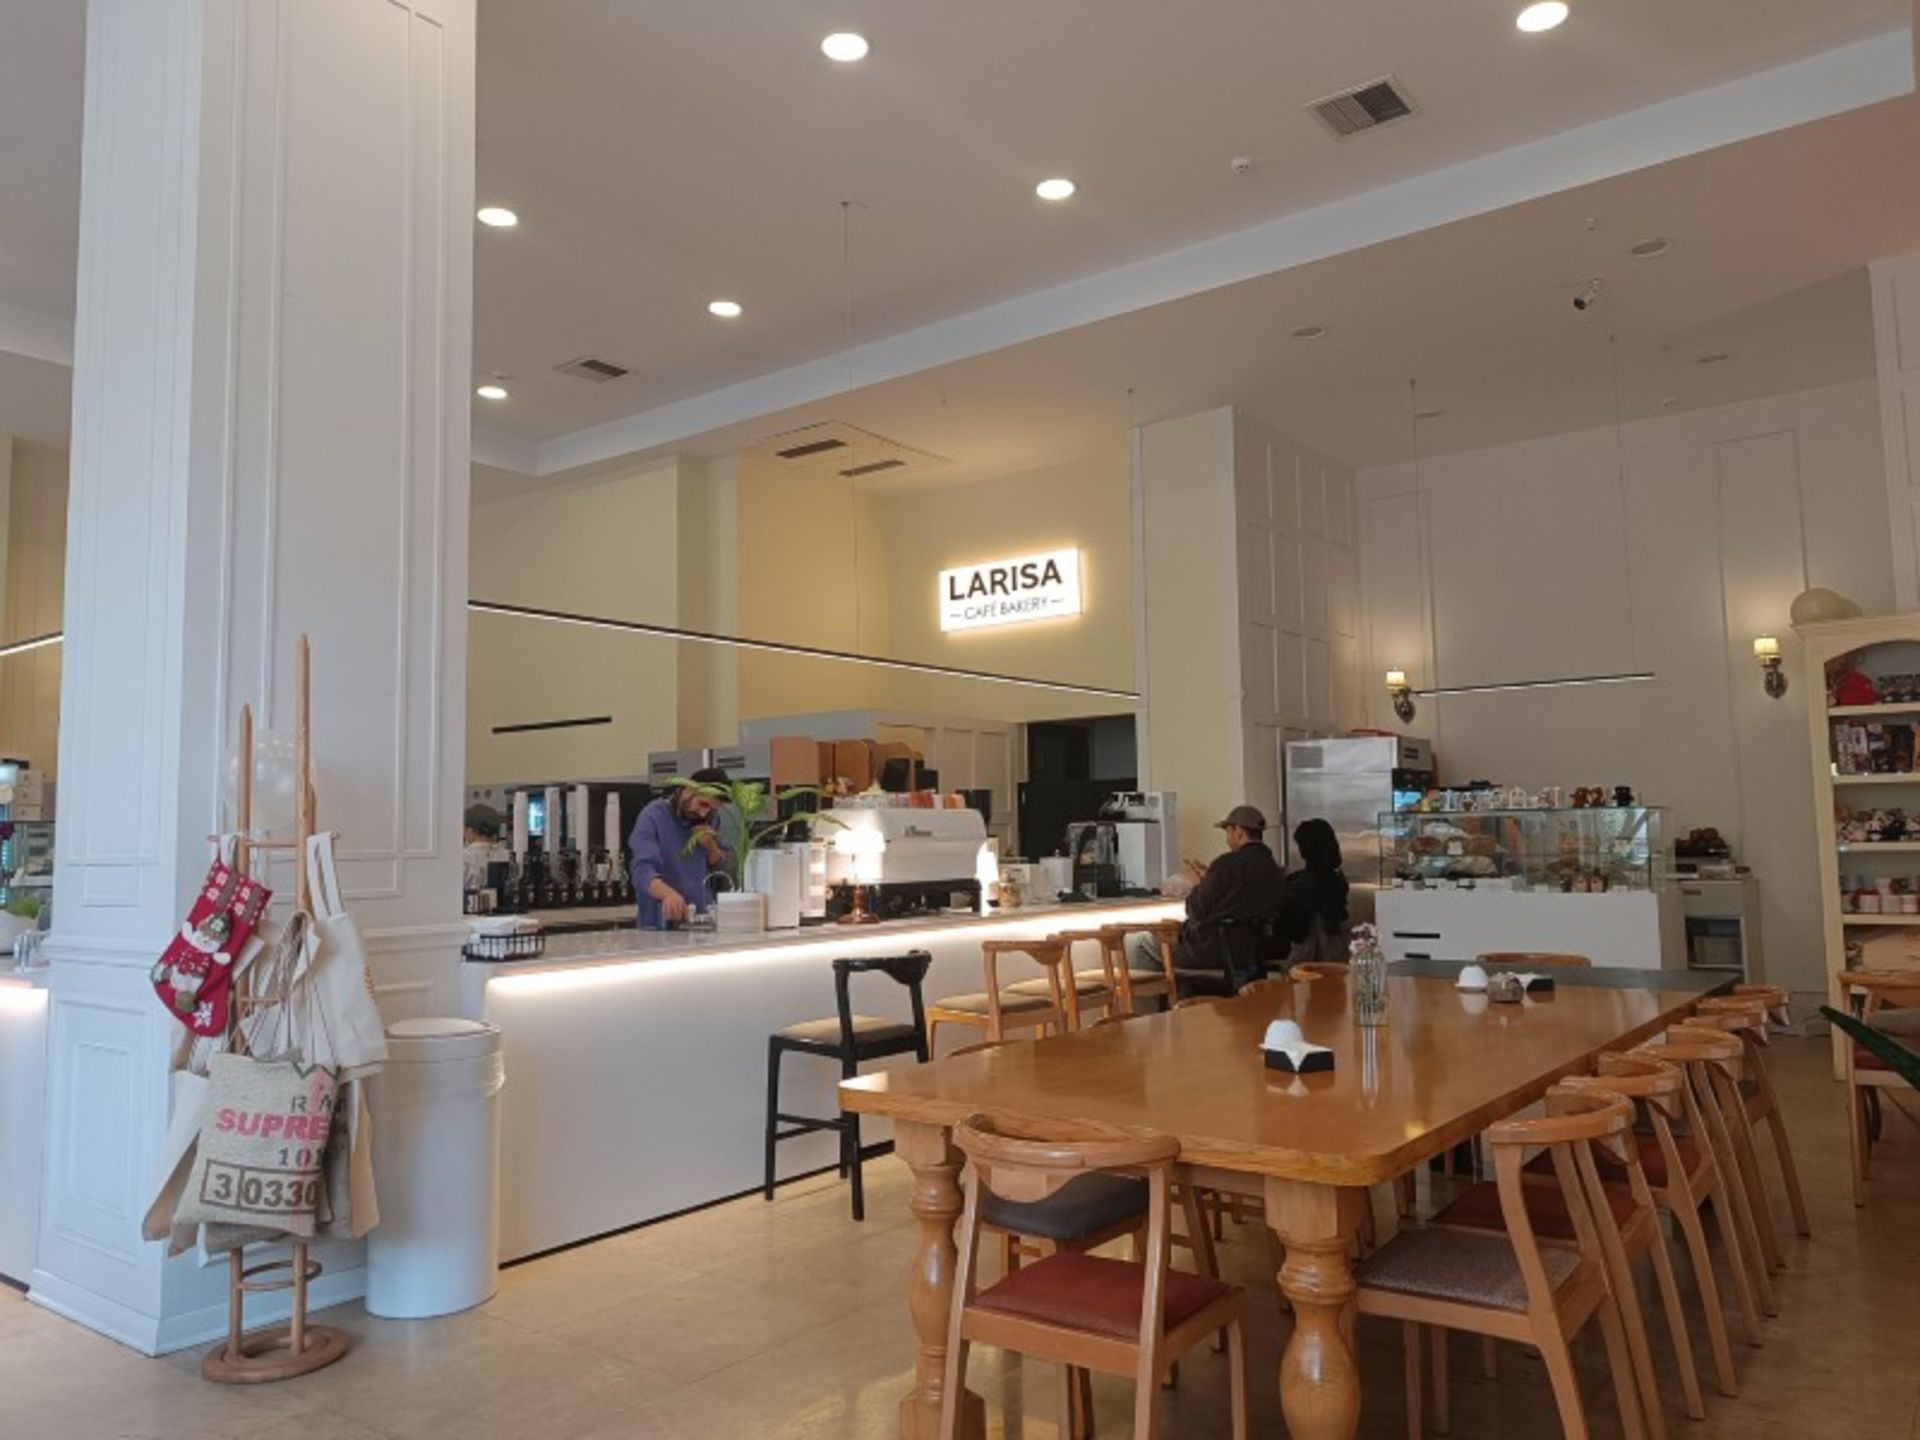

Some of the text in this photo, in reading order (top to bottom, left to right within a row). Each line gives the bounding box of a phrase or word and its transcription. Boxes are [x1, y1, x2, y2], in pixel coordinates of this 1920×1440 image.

[949, 559, 1063, 600] LARISA
[1000, 596, 1048, 615] BAKERY
[216, 1108, 330, 1141] SUPRE
[213, 1173, 233, 1201] 3
